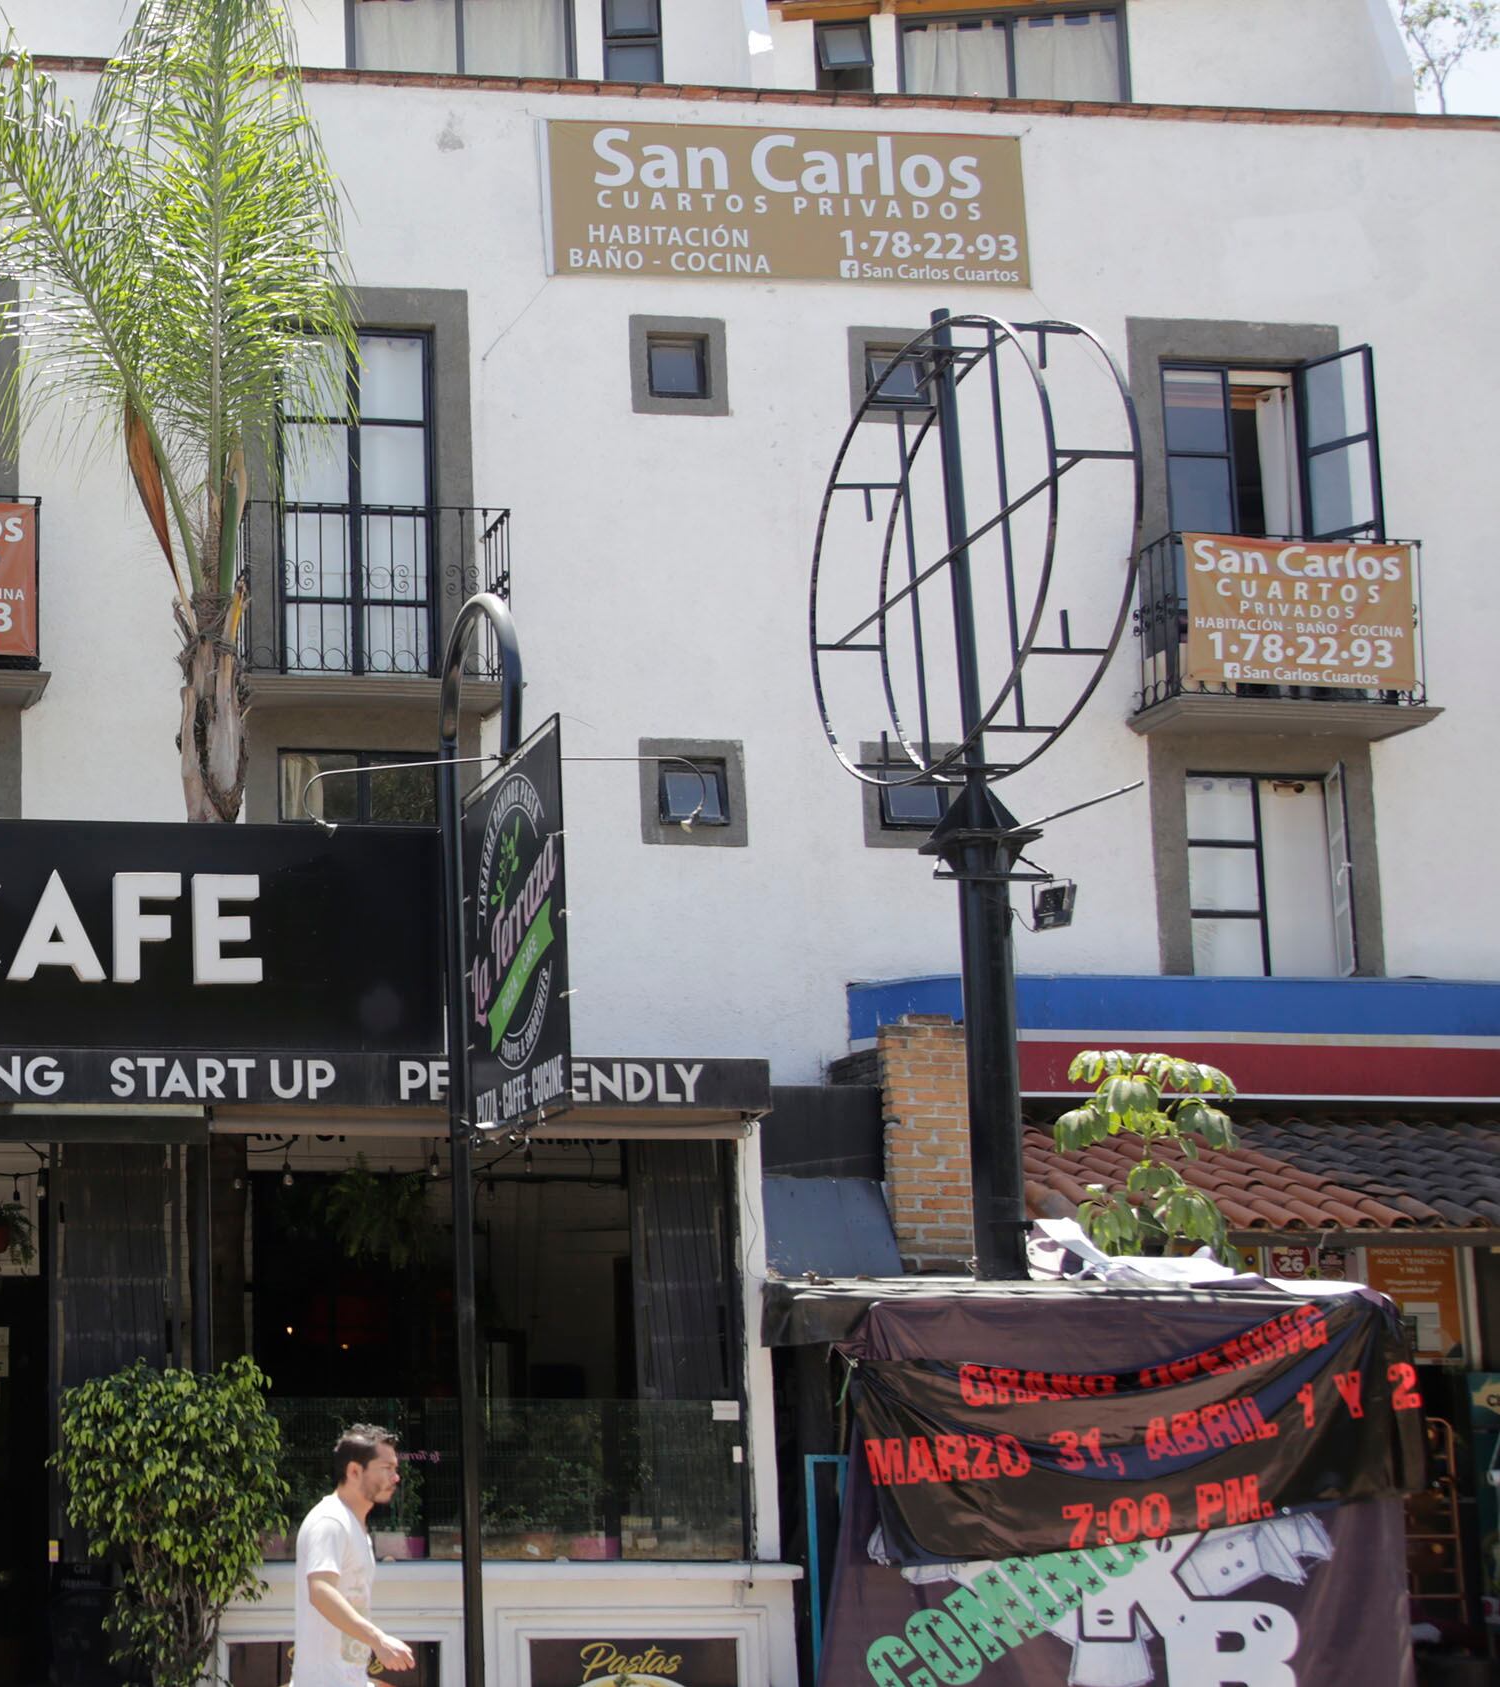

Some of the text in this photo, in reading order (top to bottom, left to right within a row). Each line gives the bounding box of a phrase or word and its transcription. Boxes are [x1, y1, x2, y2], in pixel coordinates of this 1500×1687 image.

[593, 127, 982, 199] San Carlos
[597, 190, 982, 221] CUARTOS PRIVADOS
[588, 223, 749, 248] HABITACIÓN
[569, 243, 643, 269] BAÑO
[670, 251, 771, 274] COCINA
[862, 263, 1019, 283] San Carlos Cuartos
[1193, 539, 1401, 581] San Carlos
[1216, 577, 1380, 604] CUARTOS
[1240, 600, 1355, 619] PRIVADOS
[1195, 616, 1284, 632] HABITACIÓN
[1296, 620, 1338, 635] BAÑO
[1350, 624, 1404, 638] COCINA
[1243, 665, 1379, 685] San Carlos Cuartos
[491, 834, 558, 982] Terraza
[110, 1058, 256, 1099] START
[269, 1060, 336, 1100] UP
[400, 1060, 450, 1101] PE
[572, 1062, 704, 1103] ENDLY
[476, 1088, 499, 1124] PIZZA
[864, 1363, 1421, 1486] MARZO 31, ABRIL 1 Y 2
[1061, 1473, 1275, 1550] 7:00 PM.
[580, 1642, 683, 1683] Pastas
